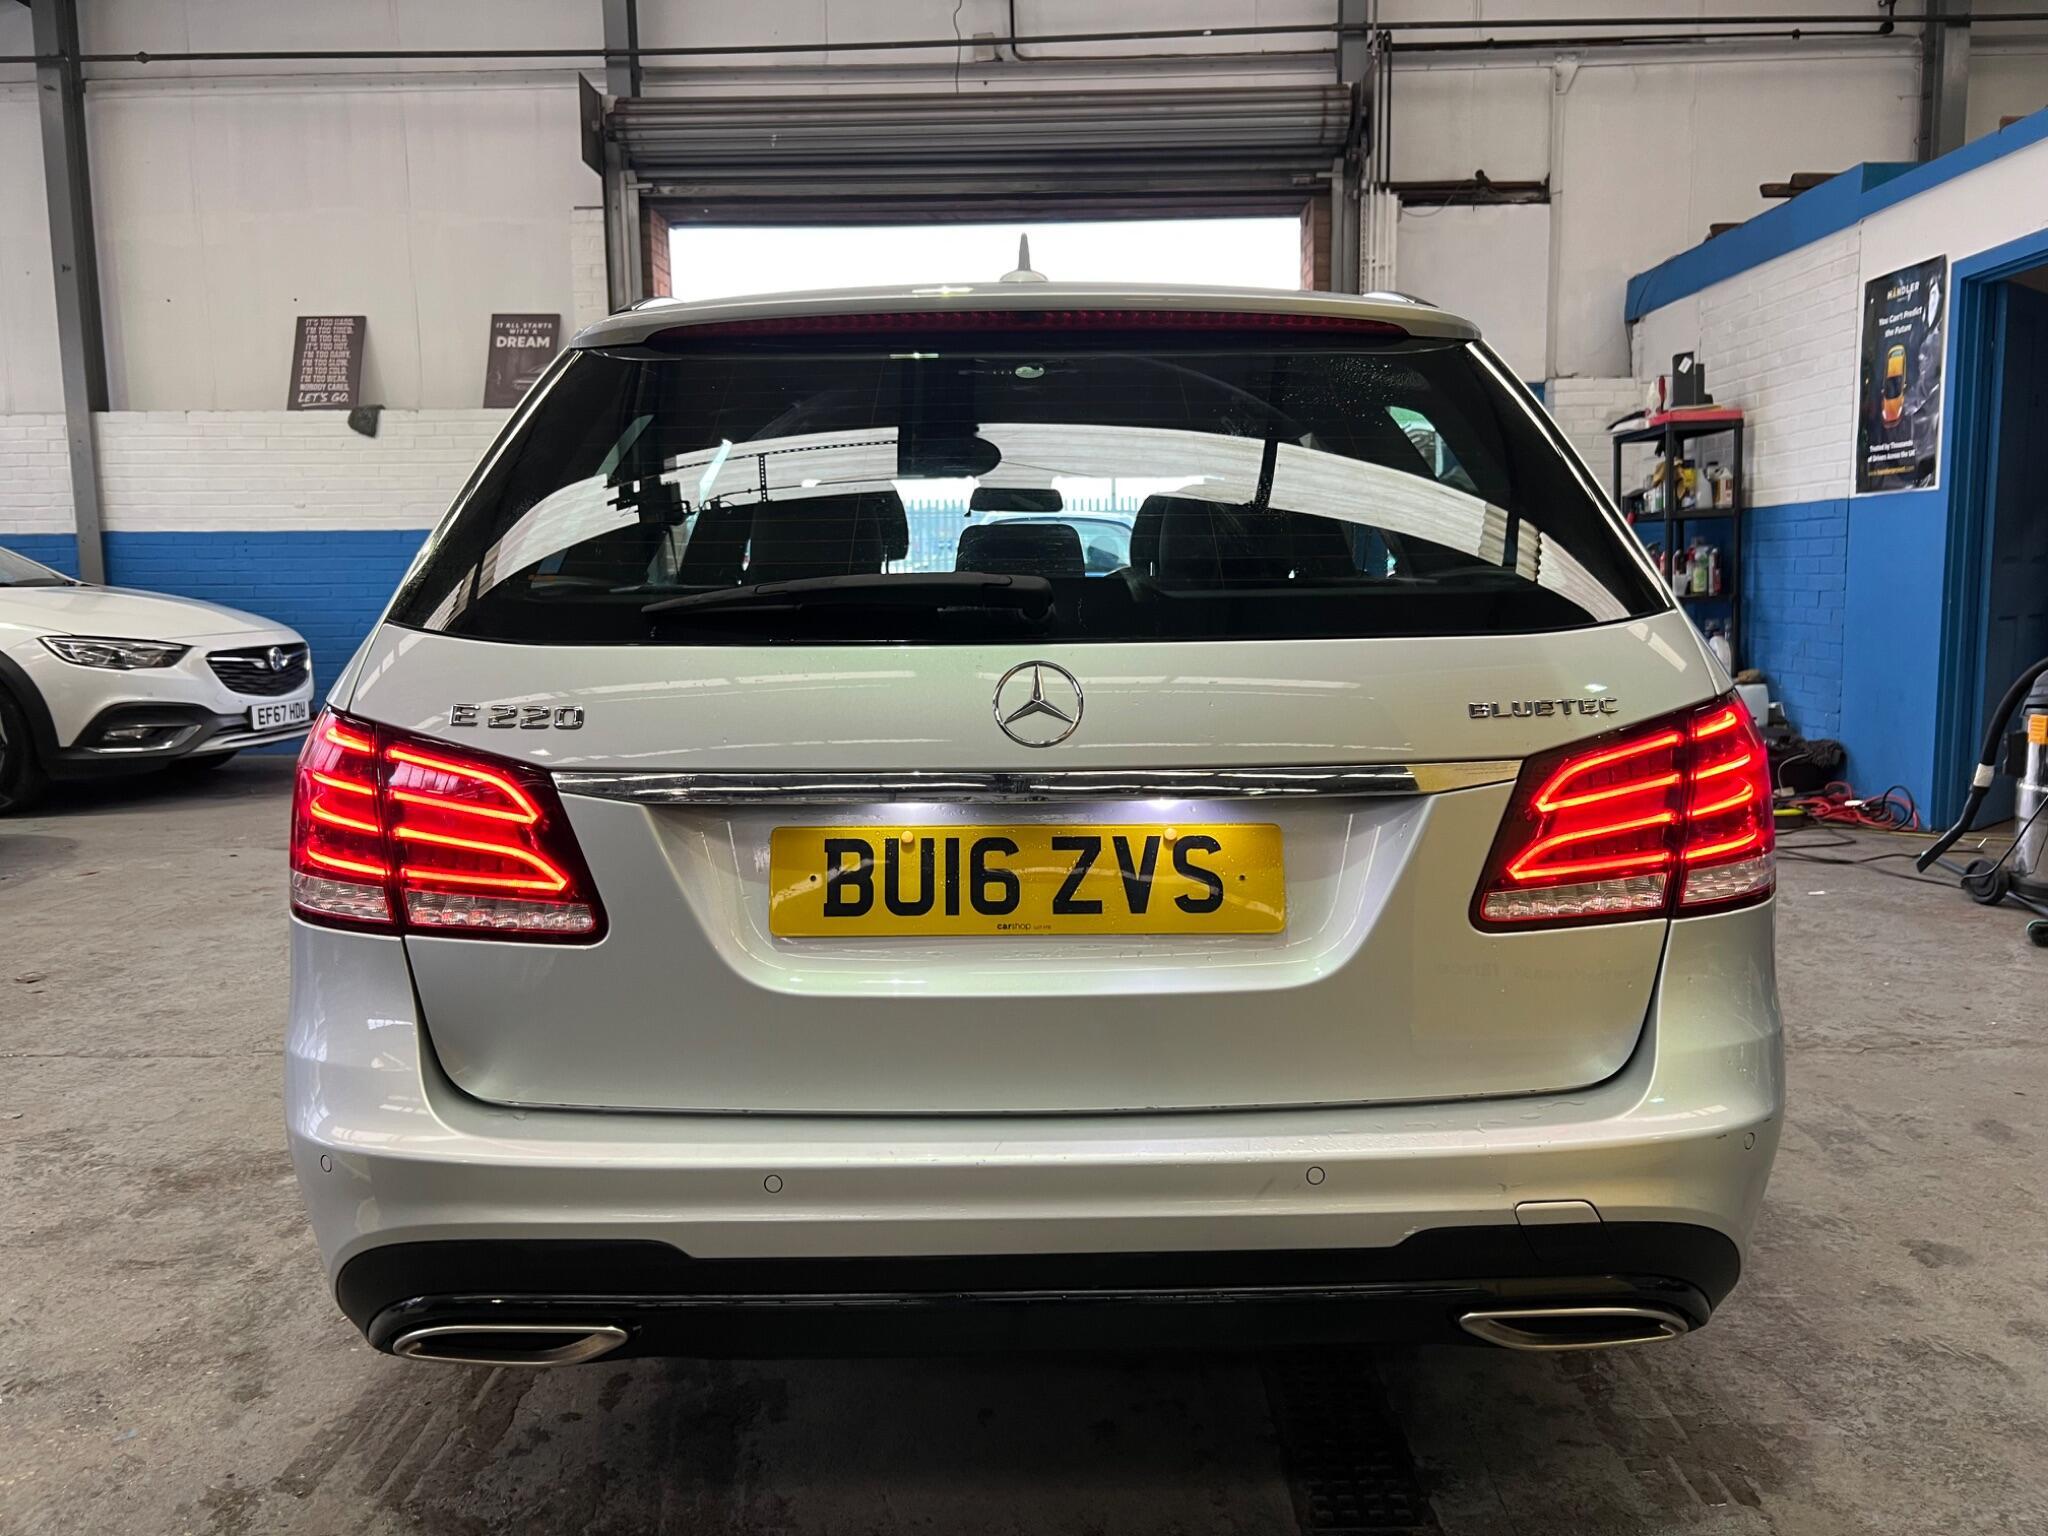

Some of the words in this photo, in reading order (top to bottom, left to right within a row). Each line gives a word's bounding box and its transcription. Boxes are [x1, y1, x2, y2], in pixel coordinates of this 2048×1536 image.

[496, 336, 550, 348] DREAM
[298, 392, 328, 403] LET'S
[258, 705, 287, 725] EF67
[449, 703, 480, 726] E
[488, 704, 585, 730] 220
[1468, 697, 1619, 718] BLUETEC
[823, 836, 1020, 917] BU16
[1051, 835, 1225, 914] ZVS
